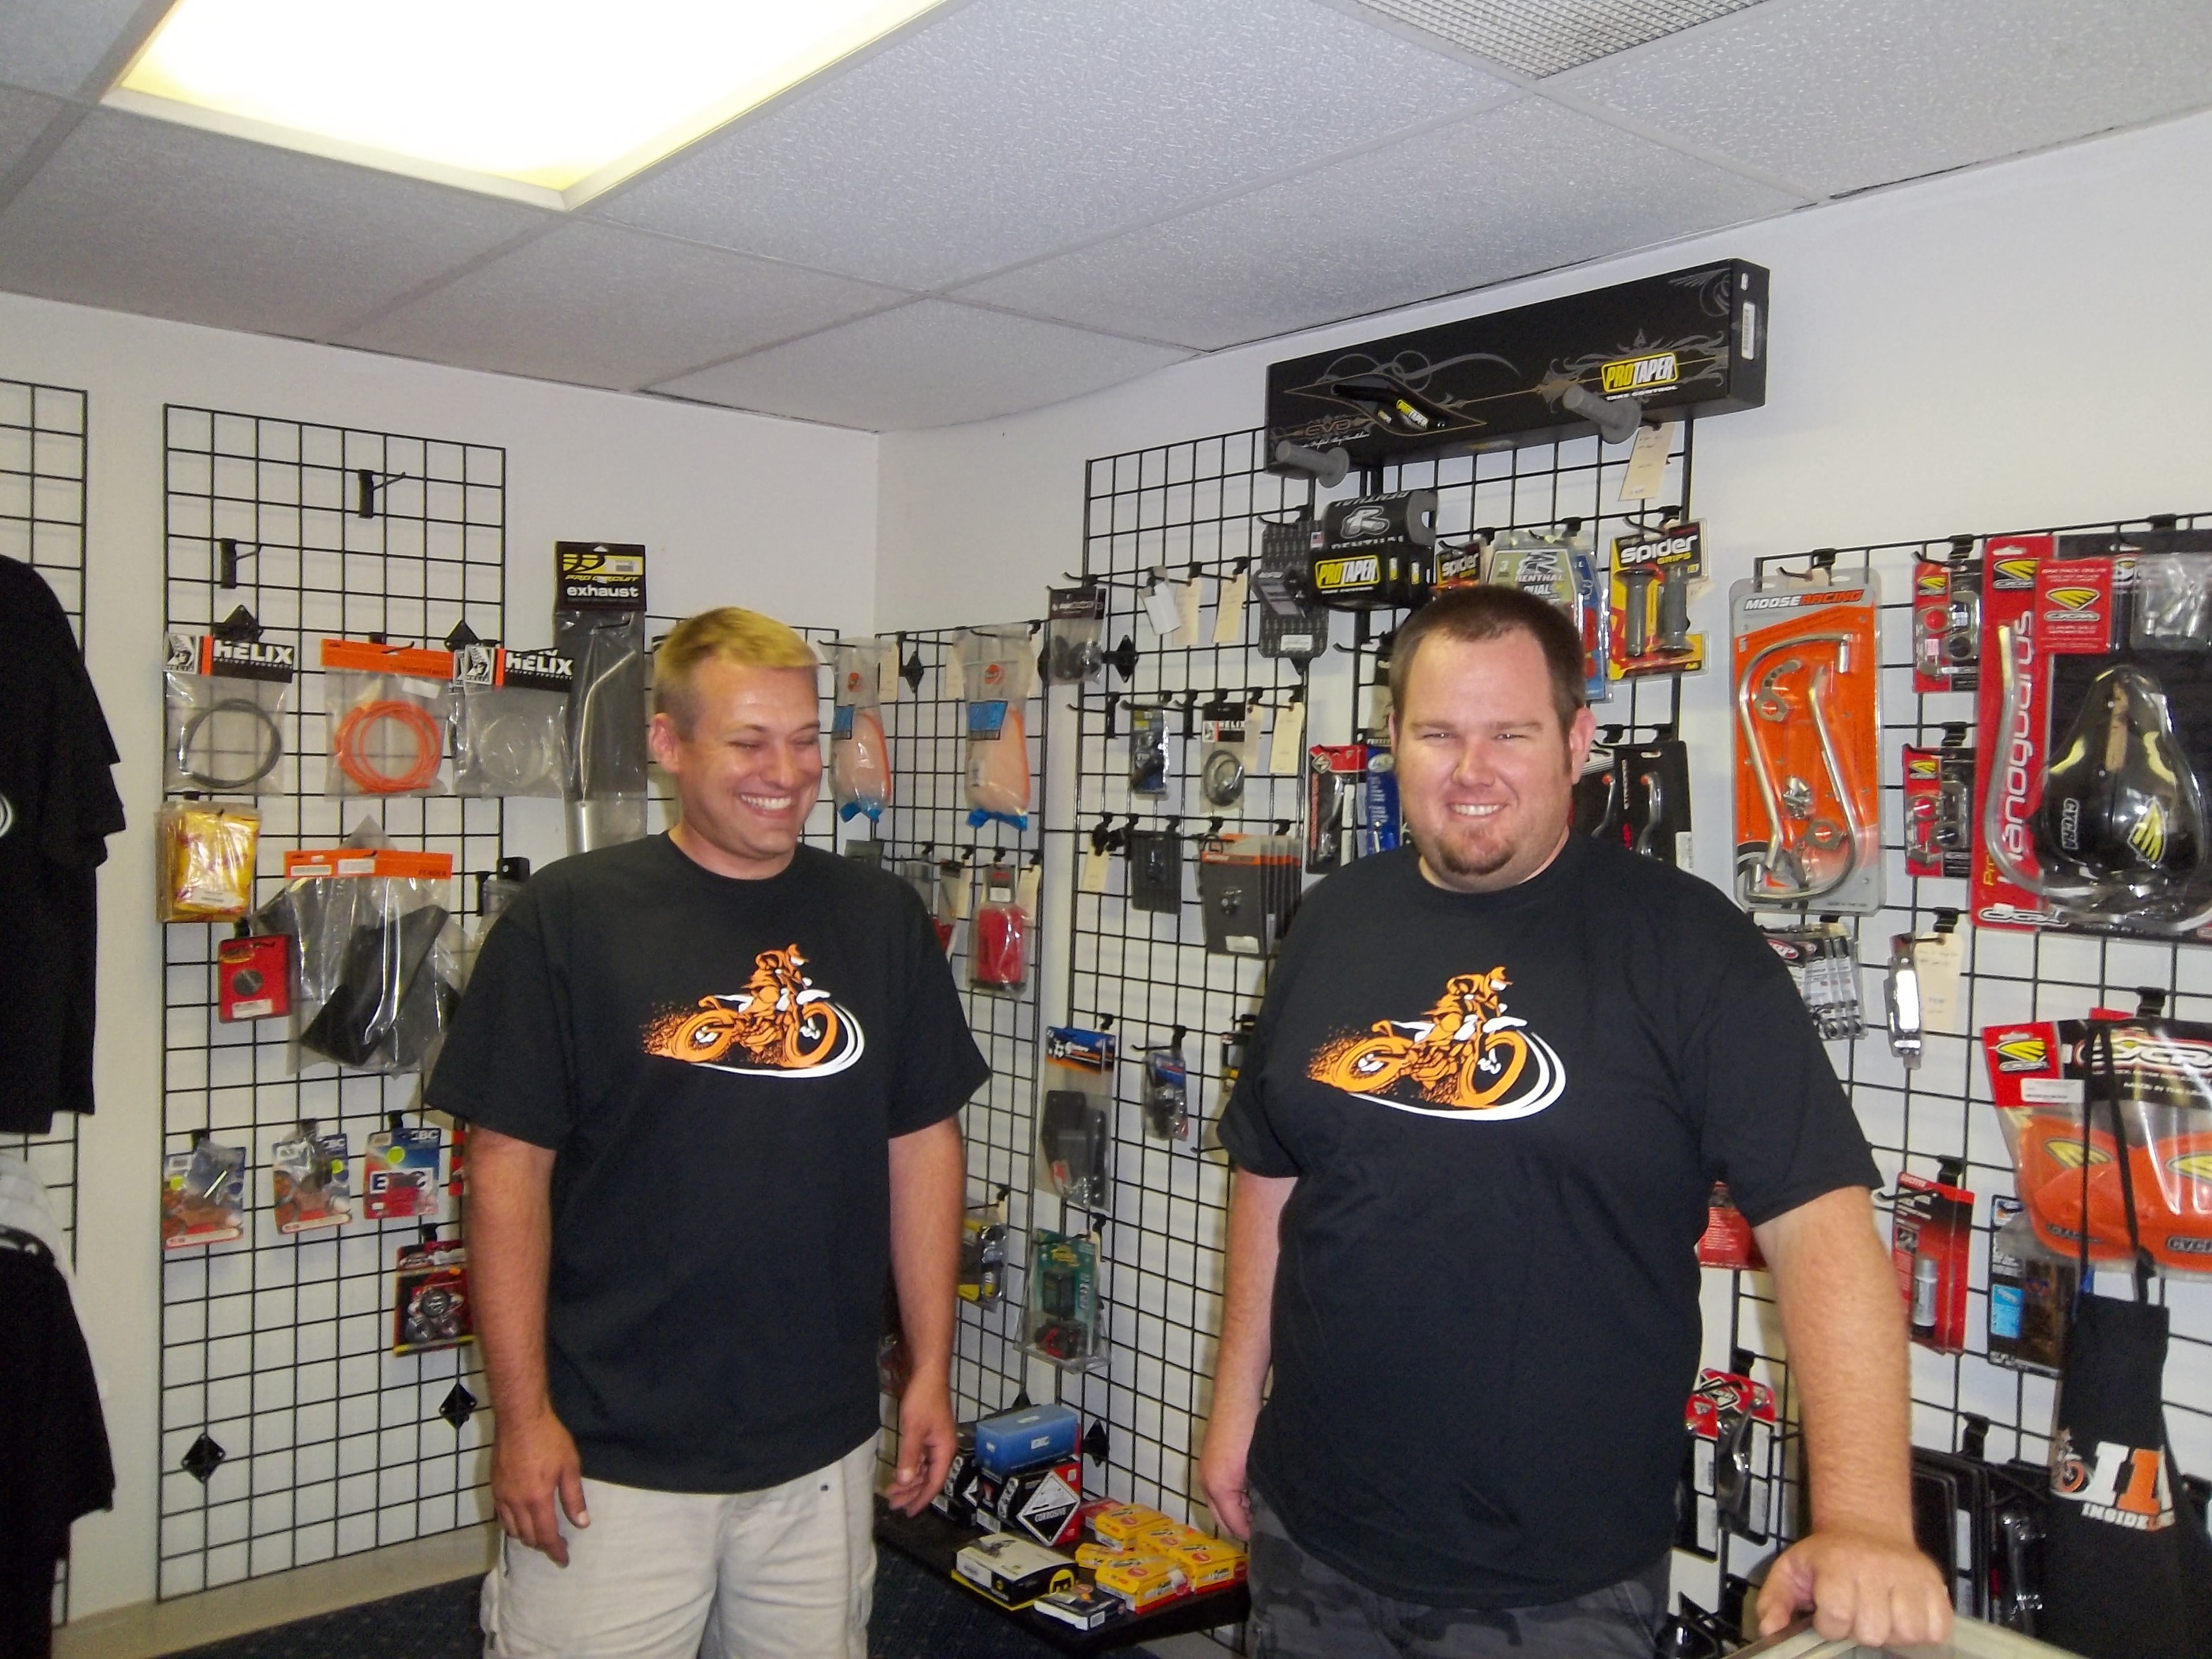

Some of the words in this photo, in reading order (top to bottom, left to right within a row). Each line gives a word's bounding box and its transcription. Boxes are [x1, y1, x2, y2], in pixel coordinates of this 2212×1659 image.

[1605, 357, 1673, 389] PROTAPER
[1620, 535, 1699, 564] spider
[1319, 559, 1377, 586] PROTAPER
[566, 585, 639, 598] exhaust
[1744, 595, 1802, 611] MOOSE
[213, 639, 294, 665] HELIX
[505, 649, 574, 676] HELIX
